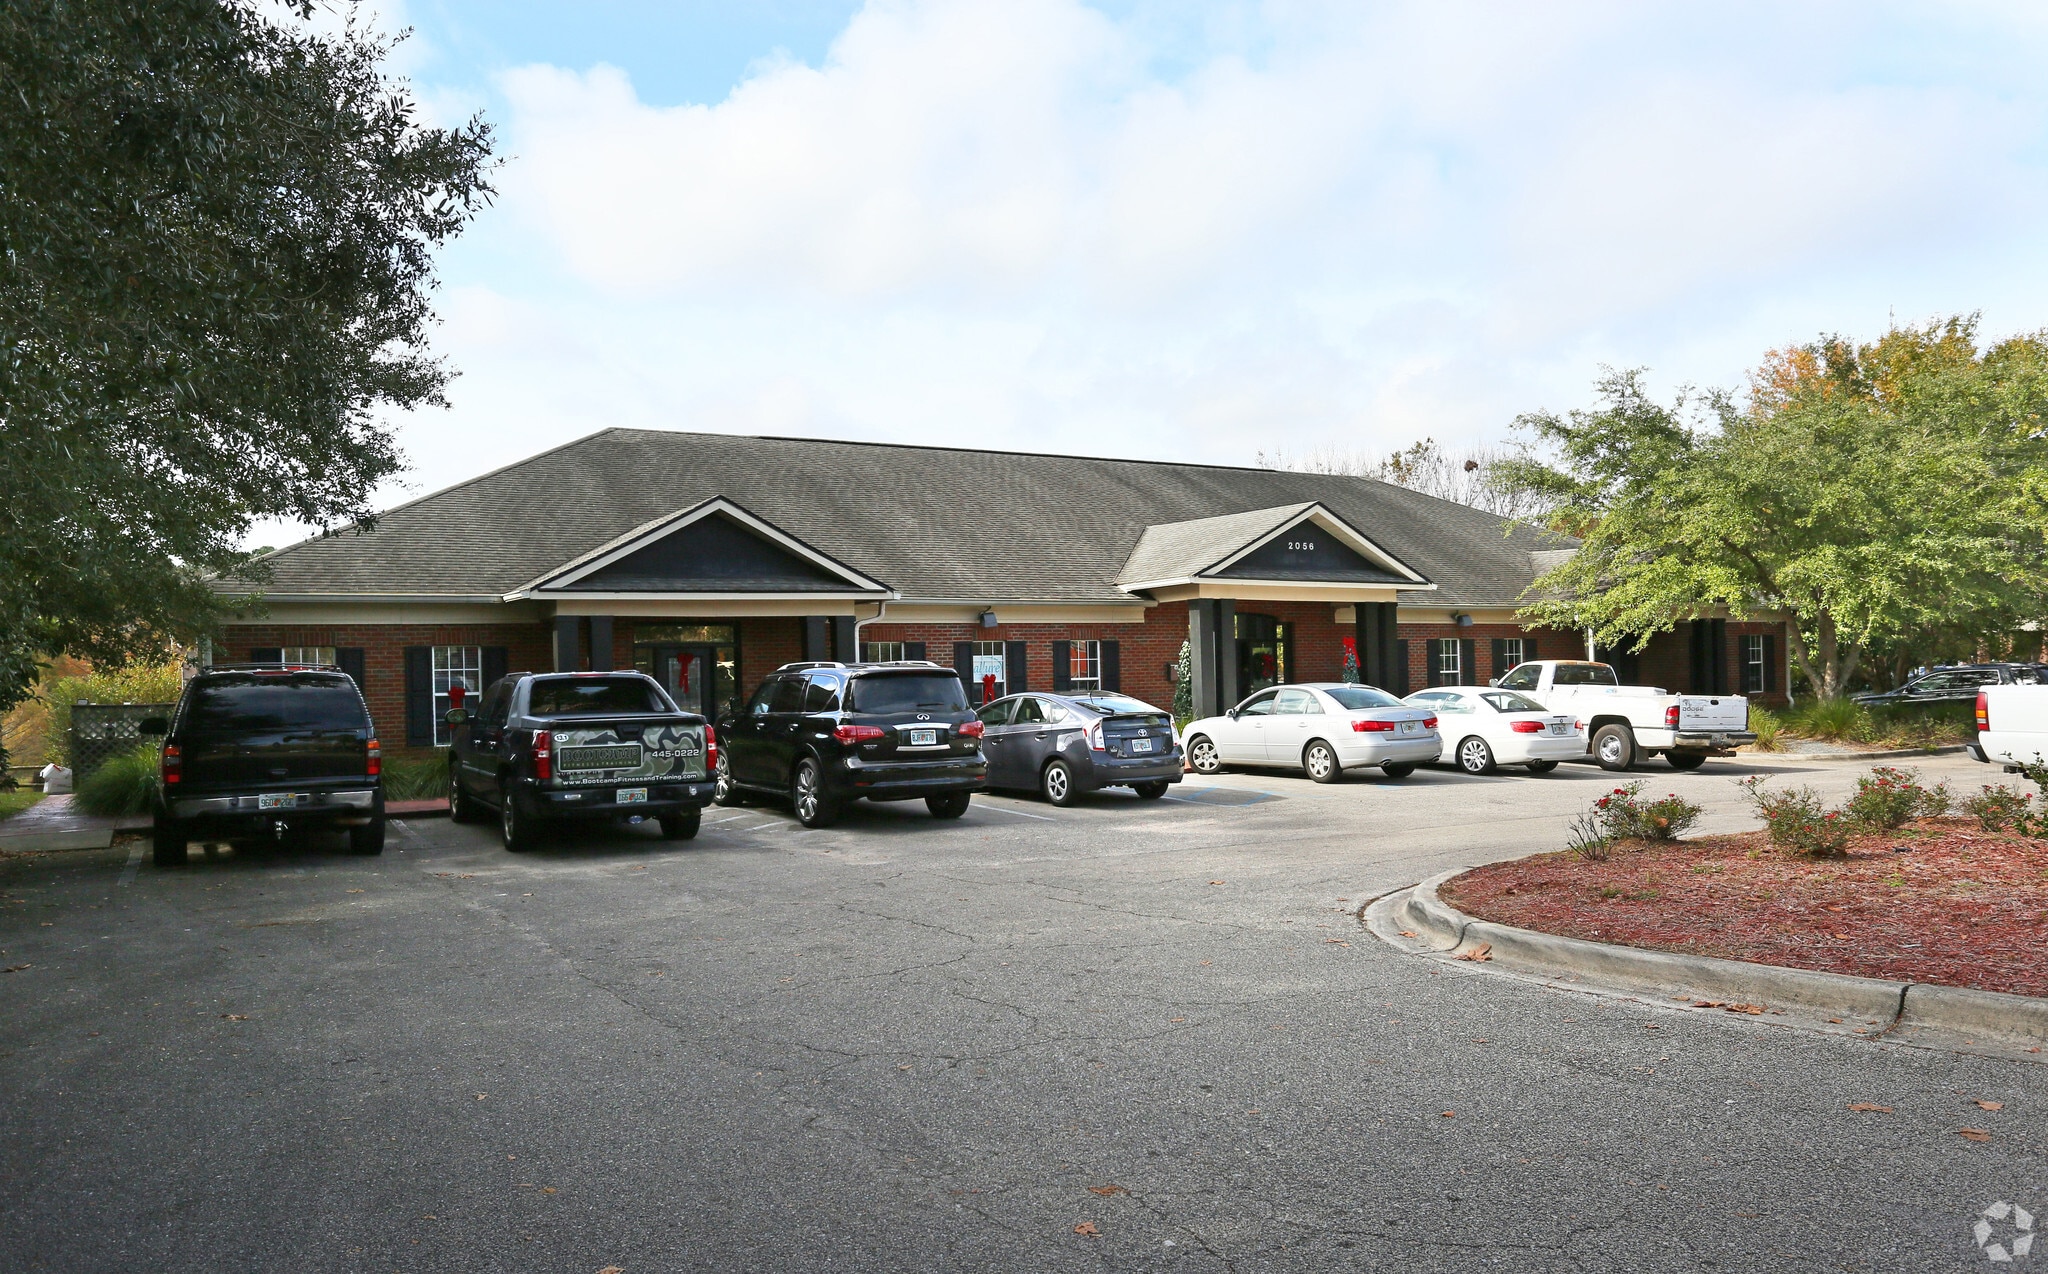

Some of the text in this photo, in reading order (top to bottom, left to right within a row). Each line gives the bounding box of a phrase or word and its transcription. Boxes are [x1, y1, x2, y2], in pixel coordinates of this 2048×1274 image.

[1288, 541, 1314, 551] 2056
[974, 661, 1001, 673] allure
[562, 747, 639, 762] BOOTCAMP
[652, 749, 700, 758] 445-0222
[562, 774, 697, 785] www.BootcampFitnessandTraining.com
